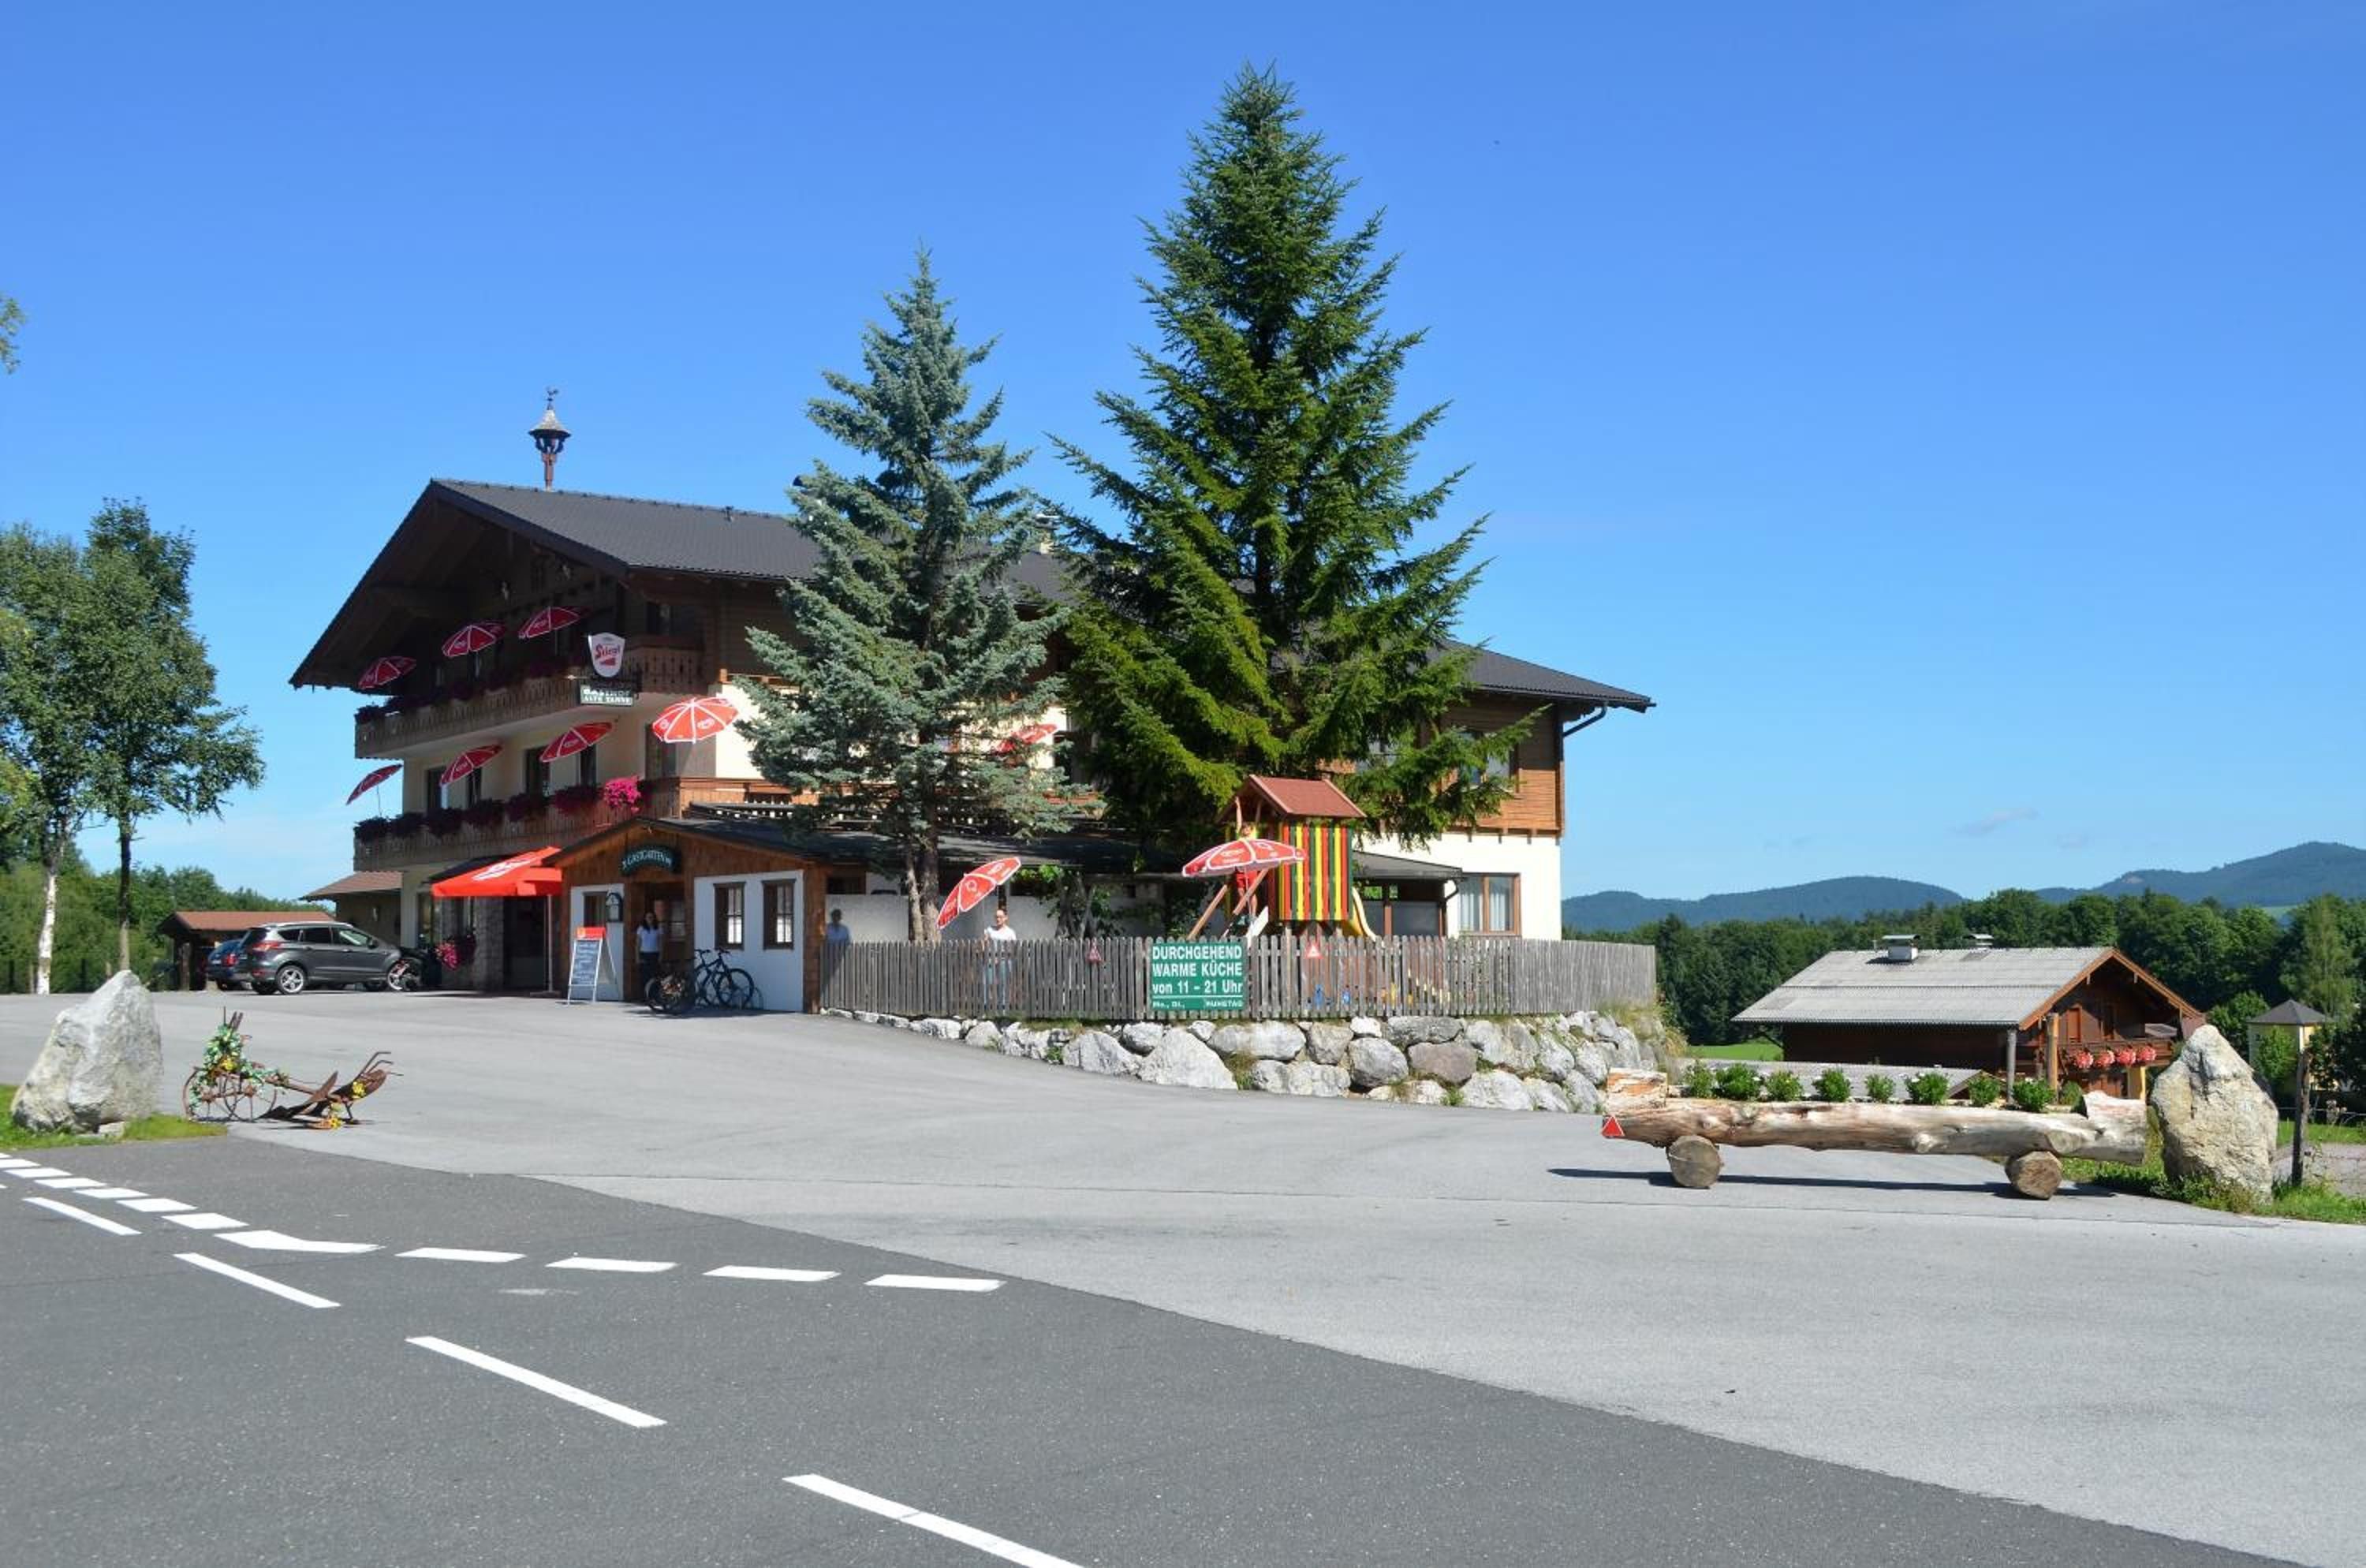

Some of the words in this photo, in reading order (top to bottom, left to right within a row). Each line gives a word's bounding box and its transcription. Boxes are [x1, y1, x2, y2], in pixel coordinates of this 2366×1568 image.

[1152, 946, 1242, 960] DURCHGEHEND
[1152, 963, 1196, 977] WARME
[1201, 959, 1242, 977] KÜCHE
[1152, 983, 1173, 995] von
[1177, 980, 1189, 994] 11
[1204, 980, 1217, 994] 21
[1222, 980, 1243, 994] Uhr
